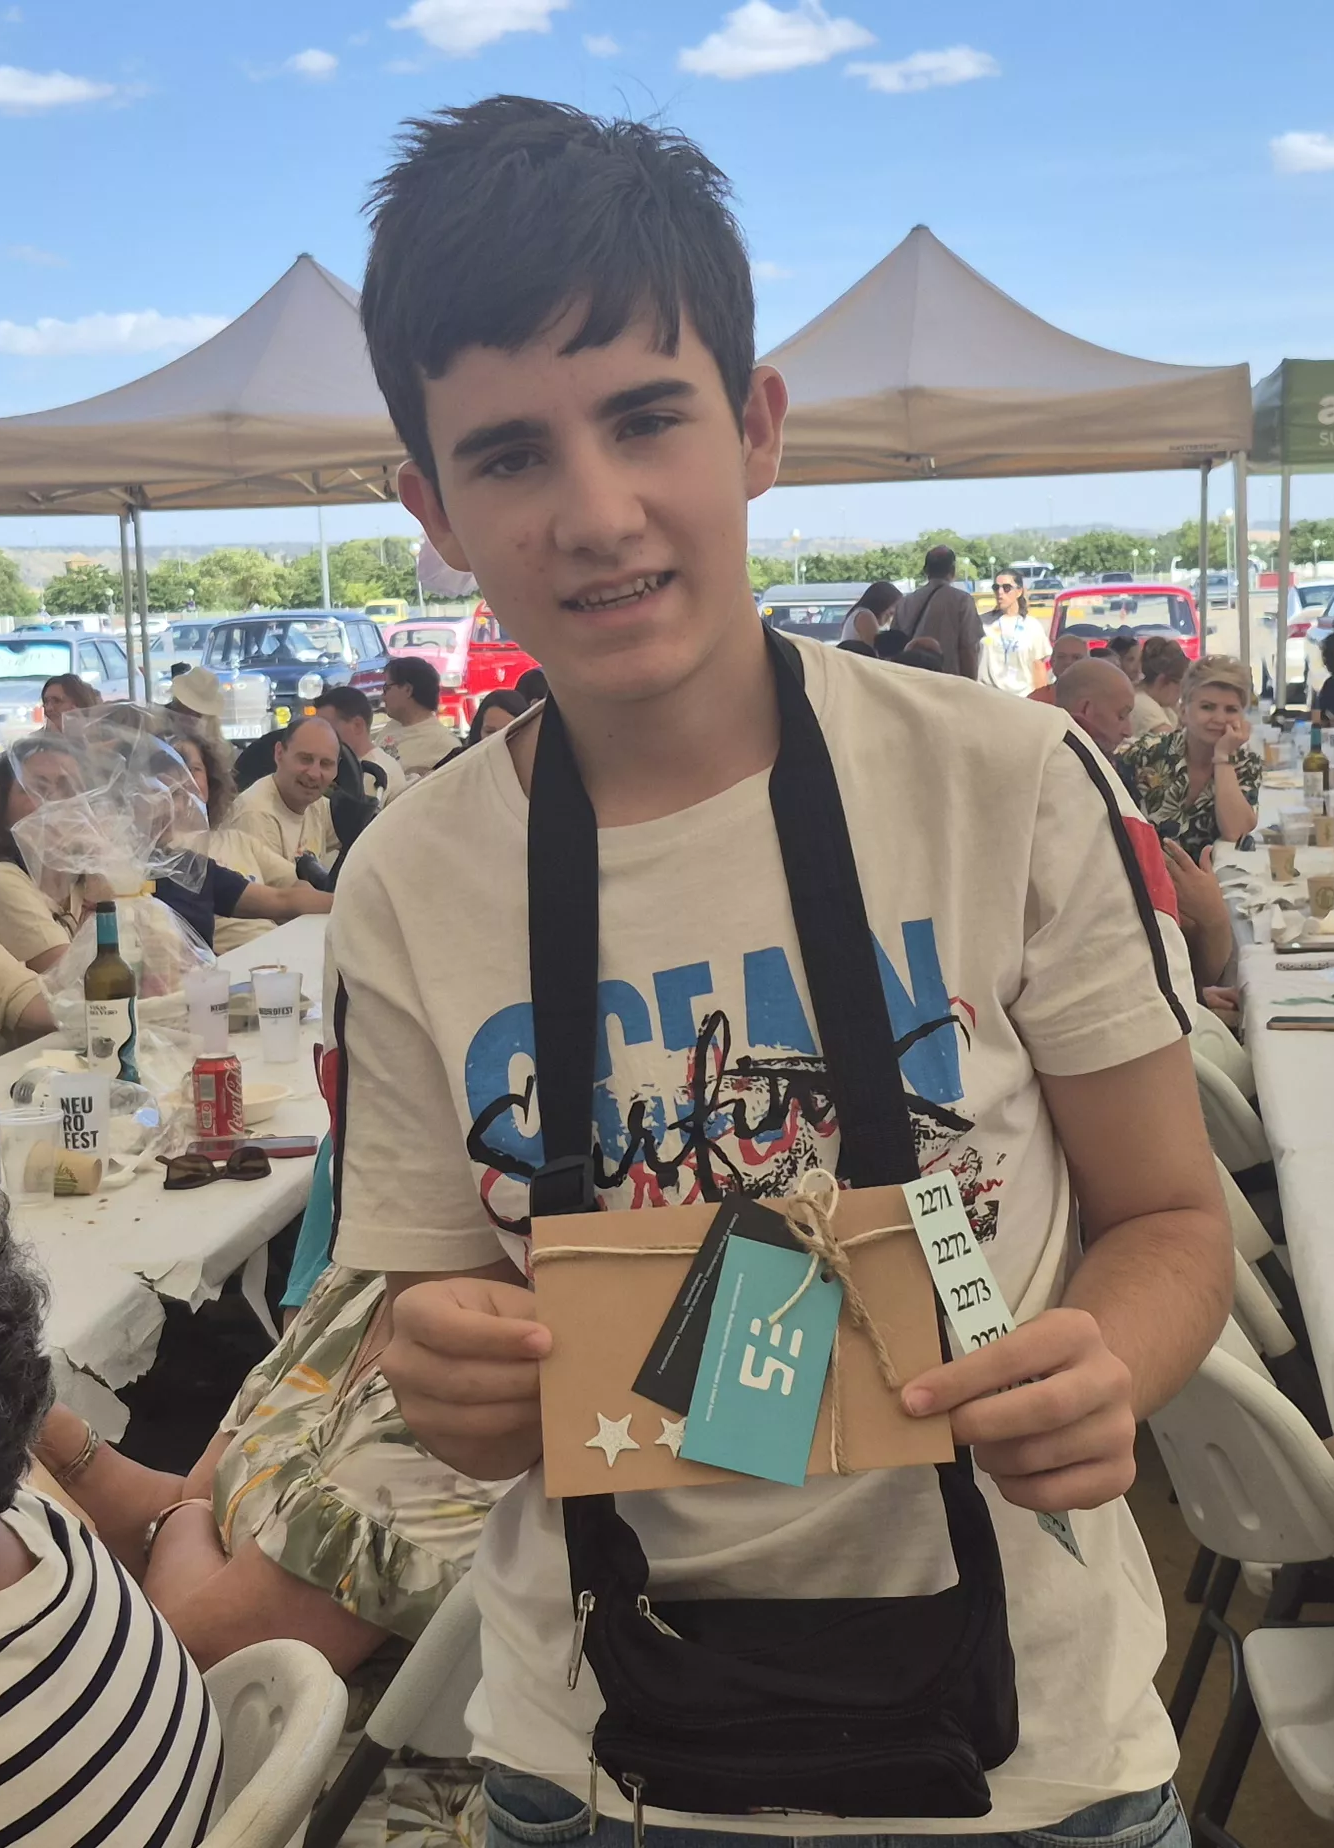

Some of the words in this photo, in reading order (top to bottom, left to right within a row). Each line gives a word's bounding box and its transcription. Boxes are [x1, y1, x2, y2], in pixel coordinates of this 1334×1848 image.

[60, 1095, 94, 1114] NEU
[63, 1114, 85, 1132] RO
[64, 1130, 100, 1150] FEST
[915, 1184, 955, 1217] 2271
[931, 1231, 972, 1265] 2272
[950, 1277, 992, 1312] 2273
